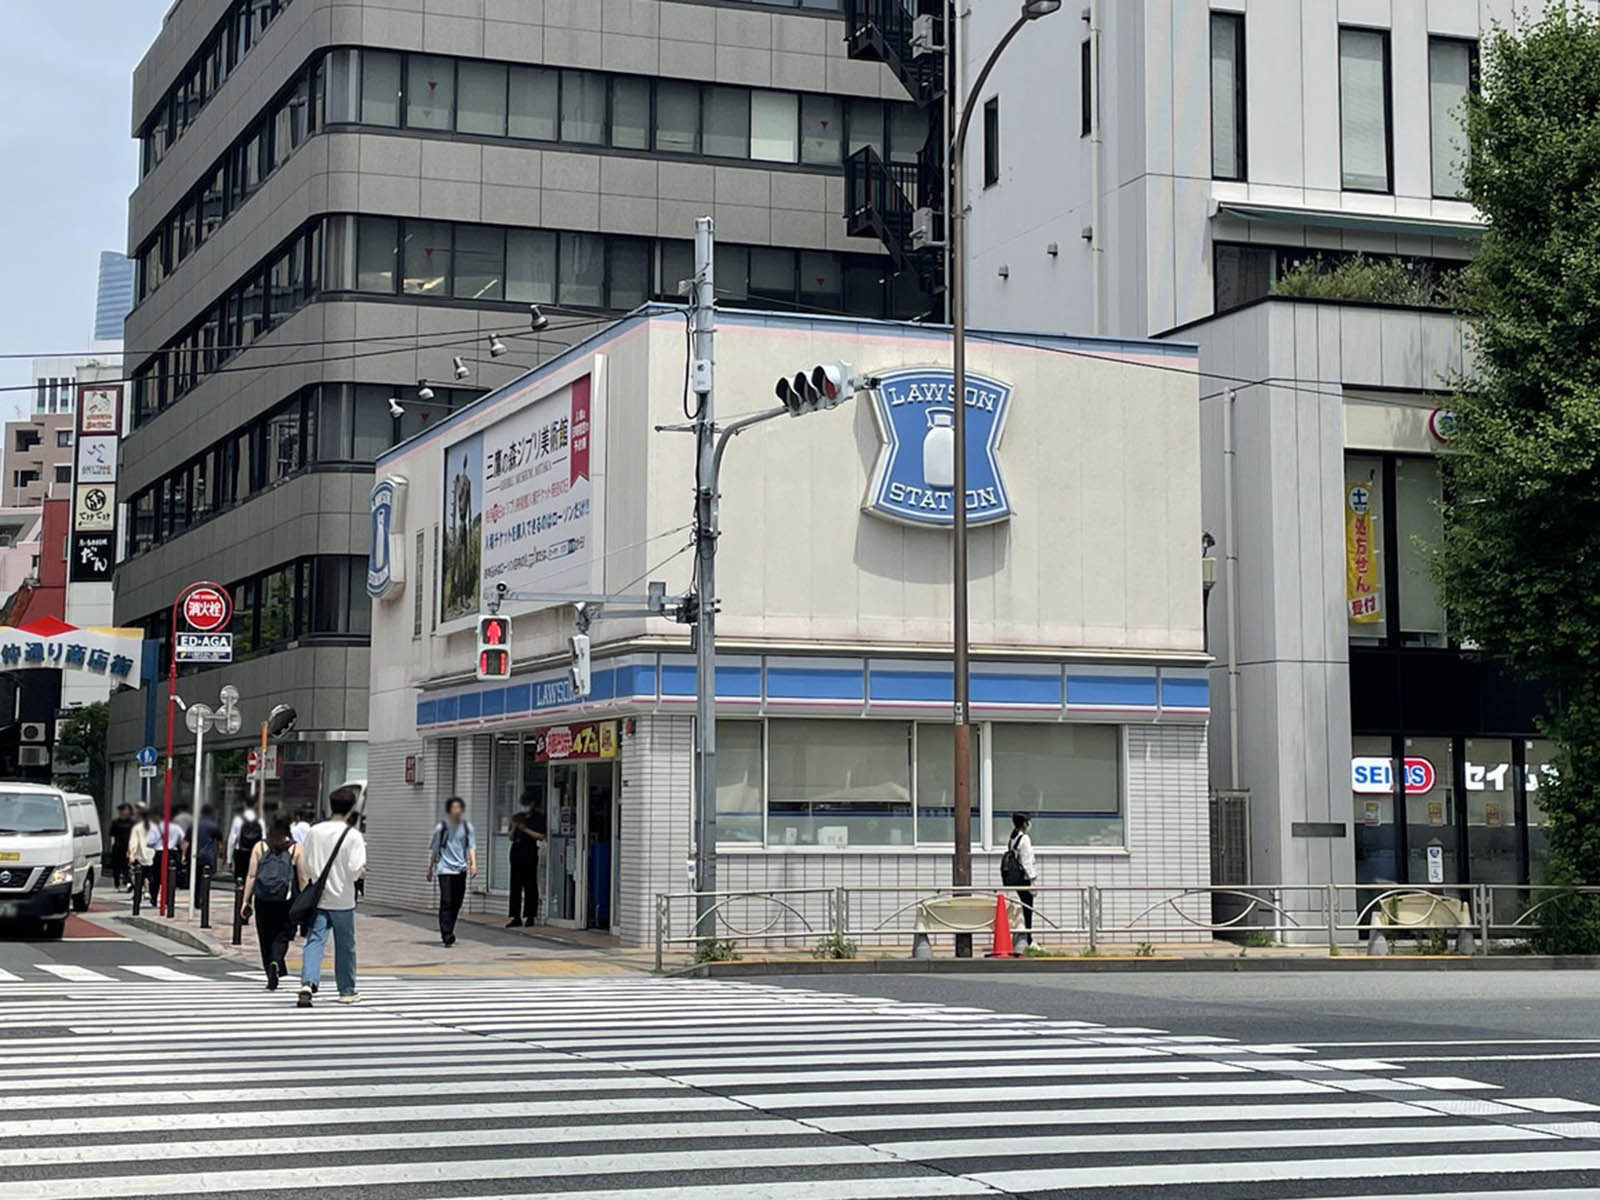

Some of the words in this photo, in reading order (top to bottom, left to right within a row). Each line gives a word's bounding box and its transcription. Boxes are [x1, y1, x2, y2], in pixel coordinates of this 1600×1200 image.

[889, 482, 997, 510] STATON
[81, 546, 107, 572] だん
[1355, 517, 1370, 593] 処方せん
[188, 601, 221, 616] 消火栓
[1352, 596, 1377, 616] 受付
[1, 642, 134, 678] 仲通り商店街
[536, 680, 577, 706] LAWSO
